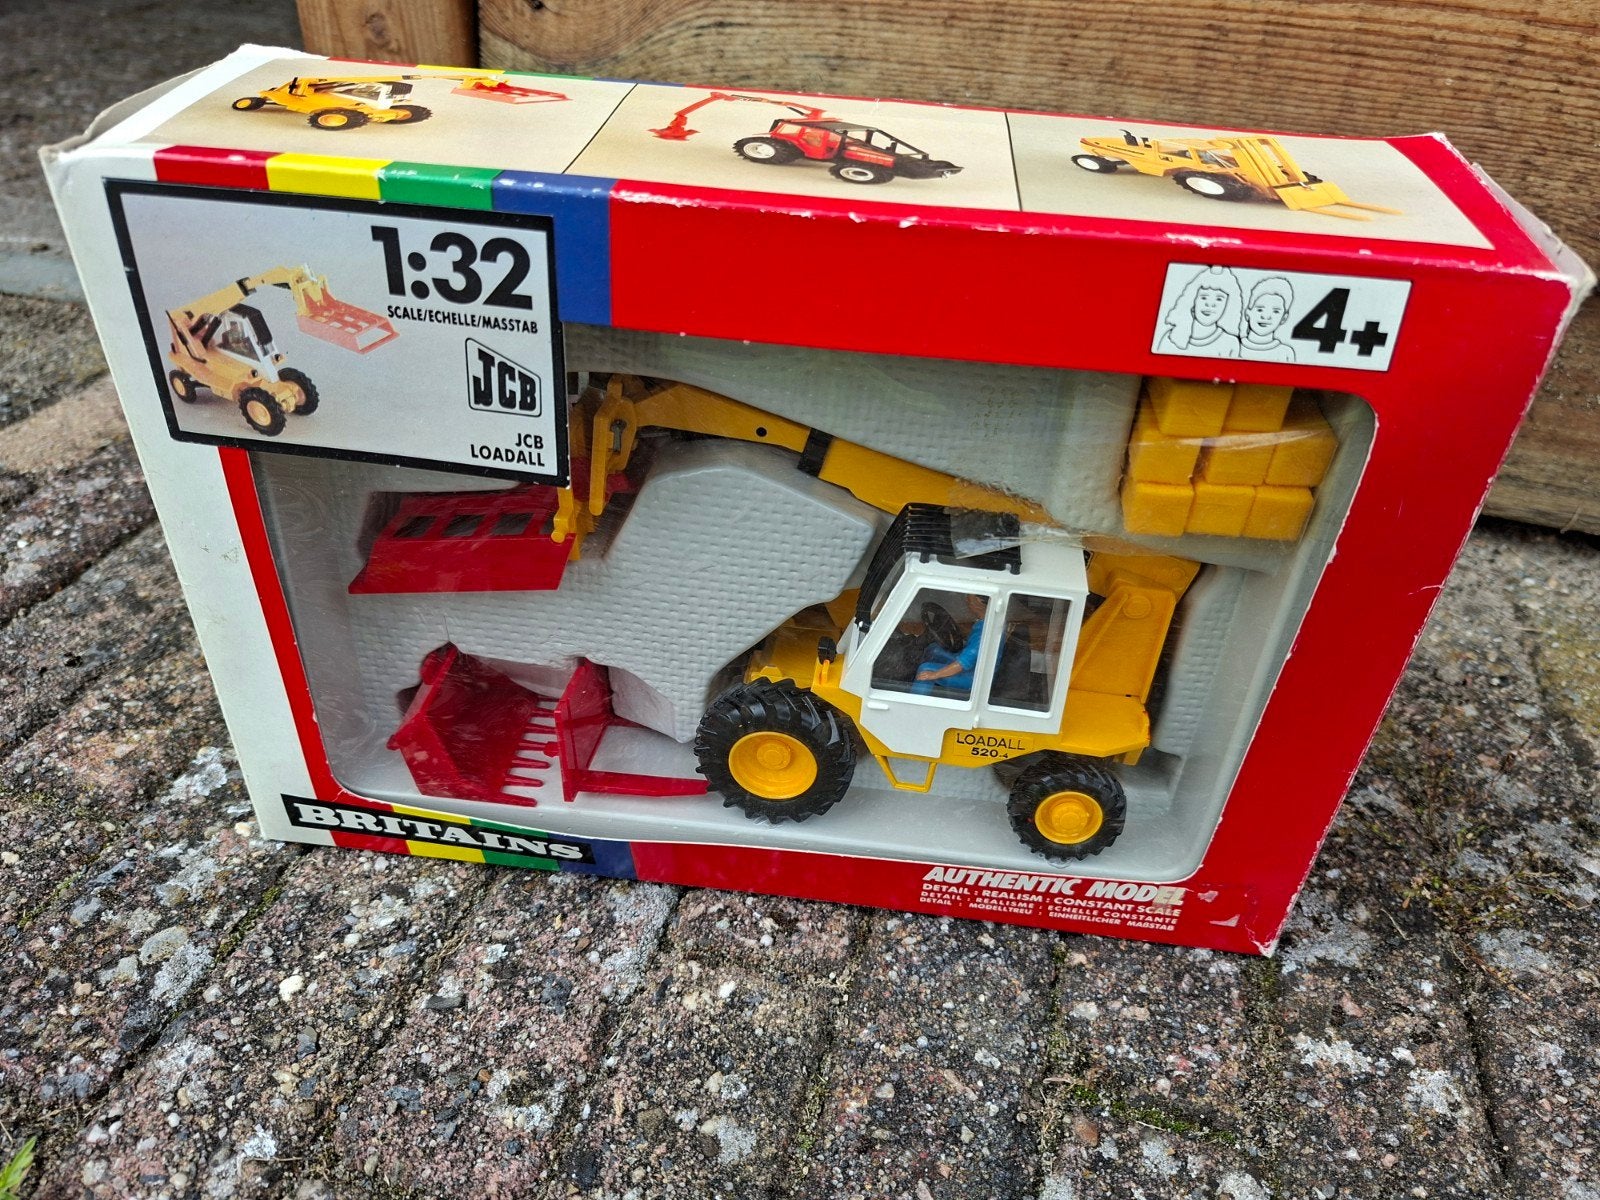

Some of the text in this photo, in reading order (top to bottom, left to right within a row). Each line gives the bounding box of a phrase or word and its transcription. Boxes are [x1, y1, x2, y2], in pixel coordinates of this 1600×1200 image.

[371, 225, 533, 310] 1:32
[387, 305, 538, 334] SCALE/ECHELLE/MASSTAB
[1291, 287, 1389, 357] 4+
[472, 347, 537, 411] JCB
[470, 444, 545, 467] LOADALL
[515, 432, 544, 450] JCB
[956, 733, 1026, 750] LOADALL
[293, 803, 584, 860] BRITAINS
[922, 867, 1188, 906] AUTHENTIC MODEL
[922, 883, 971, 896] DETAIL
[981, 889, 1043, 903] REALISM
[1053, 897, 1135, 912] CONSTANT
[1136, 905, 1182, 917] SCALE
[919, 897, 953, 906] DETAIL
[968, 902, 1033, 915] MODELLTREU
[1048, 911, 1122, 925] EINHEITLICHER
[920, 891, 962, 901] DETAIL
[975, 897, 1035, 909] REALISME
[1047, 905, 1099, 916] ECHELLE
[1102, 911, 1179, 925] CONSTANTE
